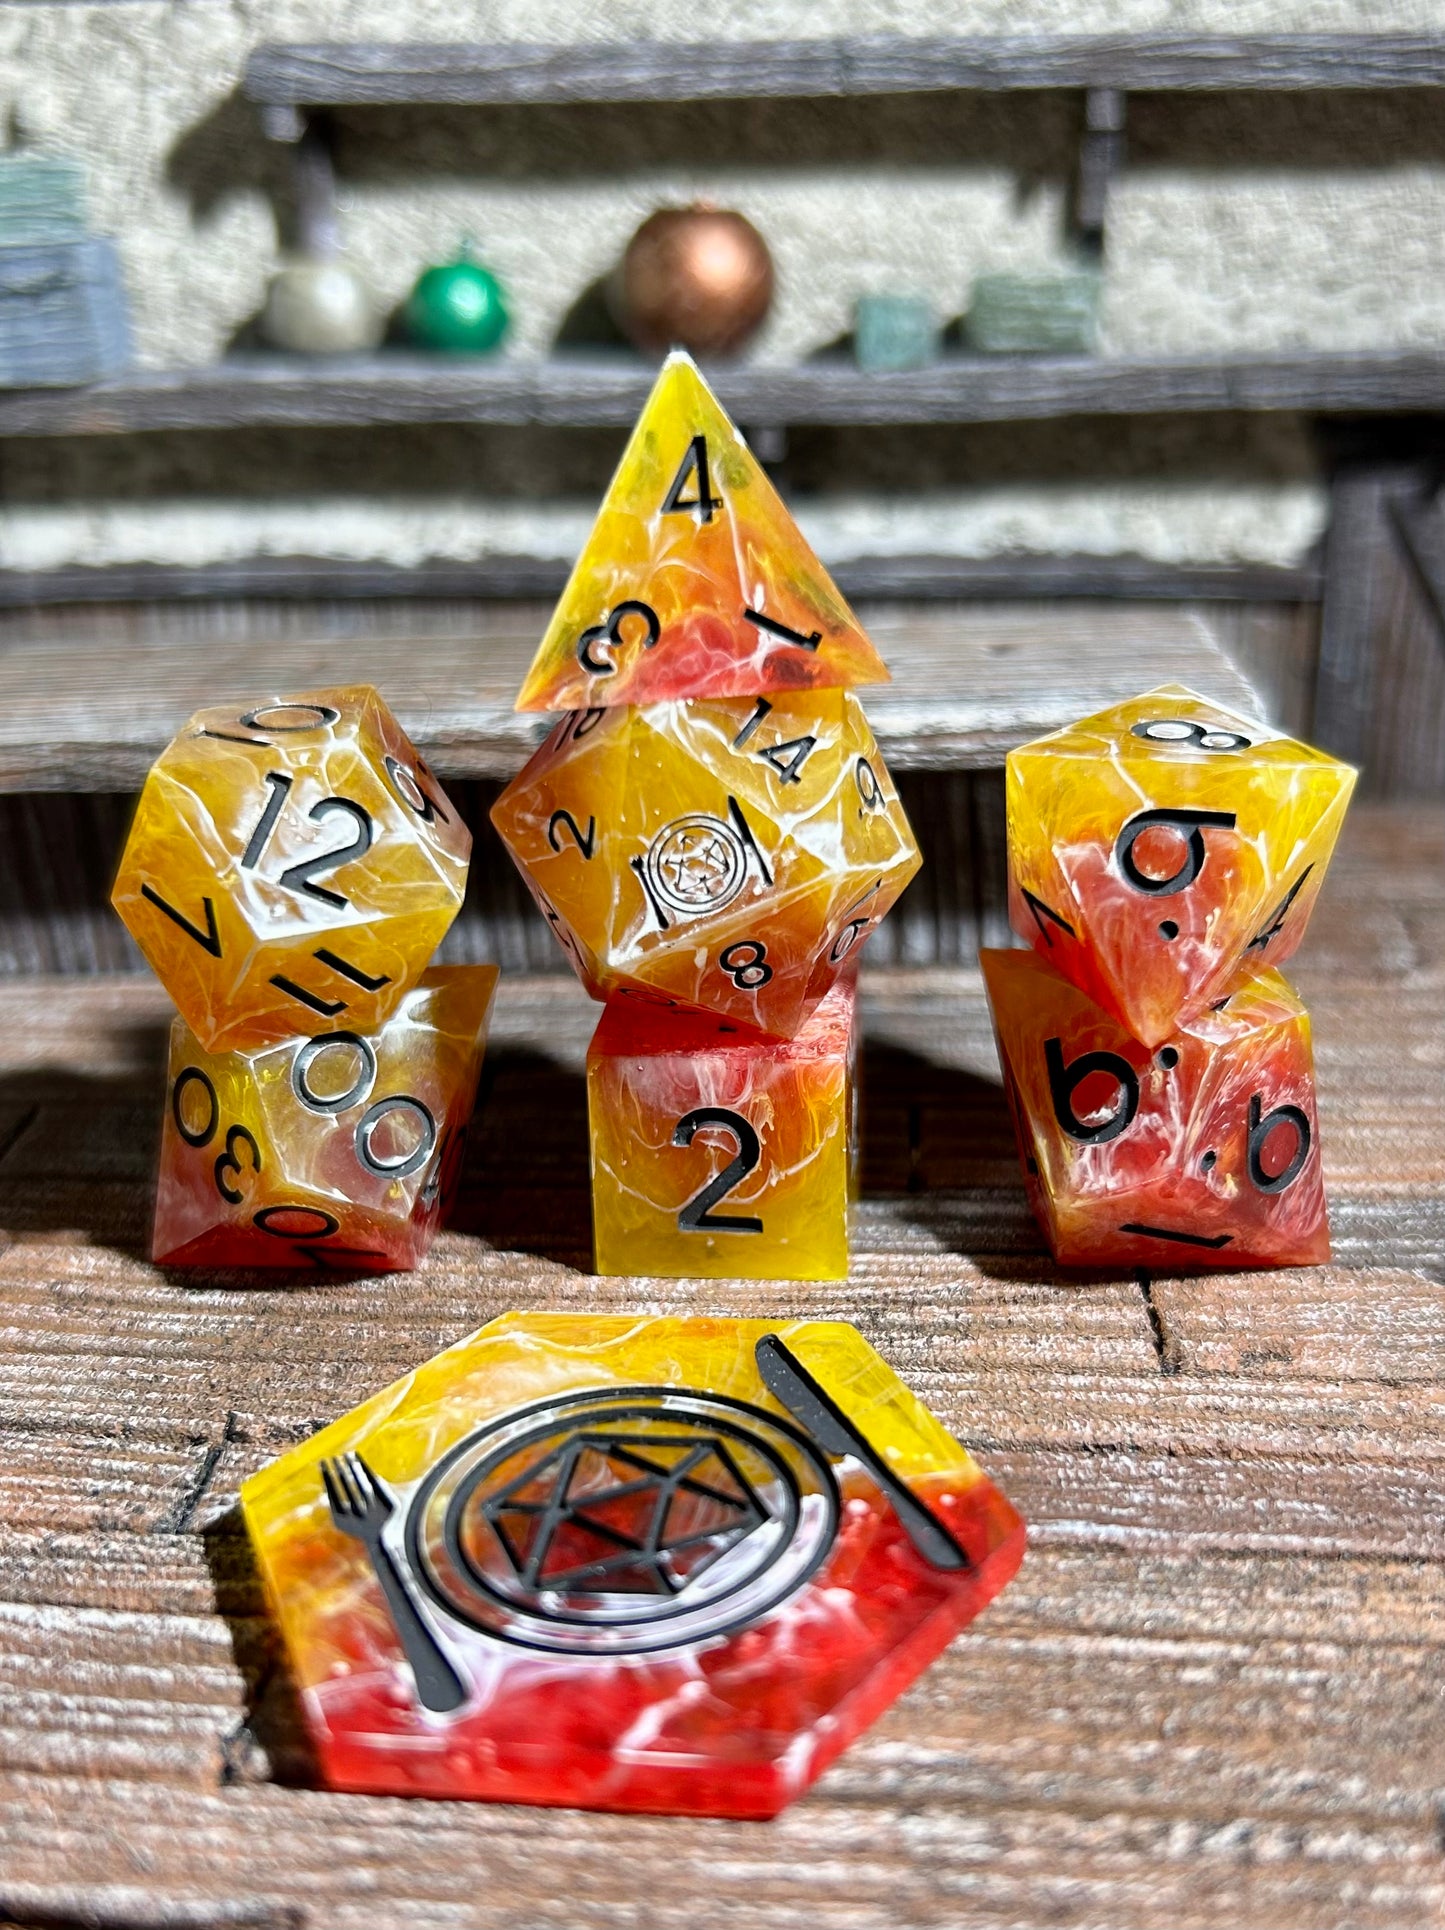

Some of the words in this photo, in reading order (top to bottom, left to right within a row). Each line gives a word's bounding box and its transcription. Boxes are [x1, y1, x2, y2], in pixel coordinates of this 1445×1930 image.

[660, 435, 724, 523] 4
[576, 600, 661, 675] 3
[744, 607, 822, 652] 1
[201, 703, 339, 747] 10
[1131, 720, 1251, 751] 8
[241, 772, 374, 910] 12
[548, 809, 596, 860] 2
[719, 940, 773, 990] 8
[672, 1107, 763, 1233] 2
